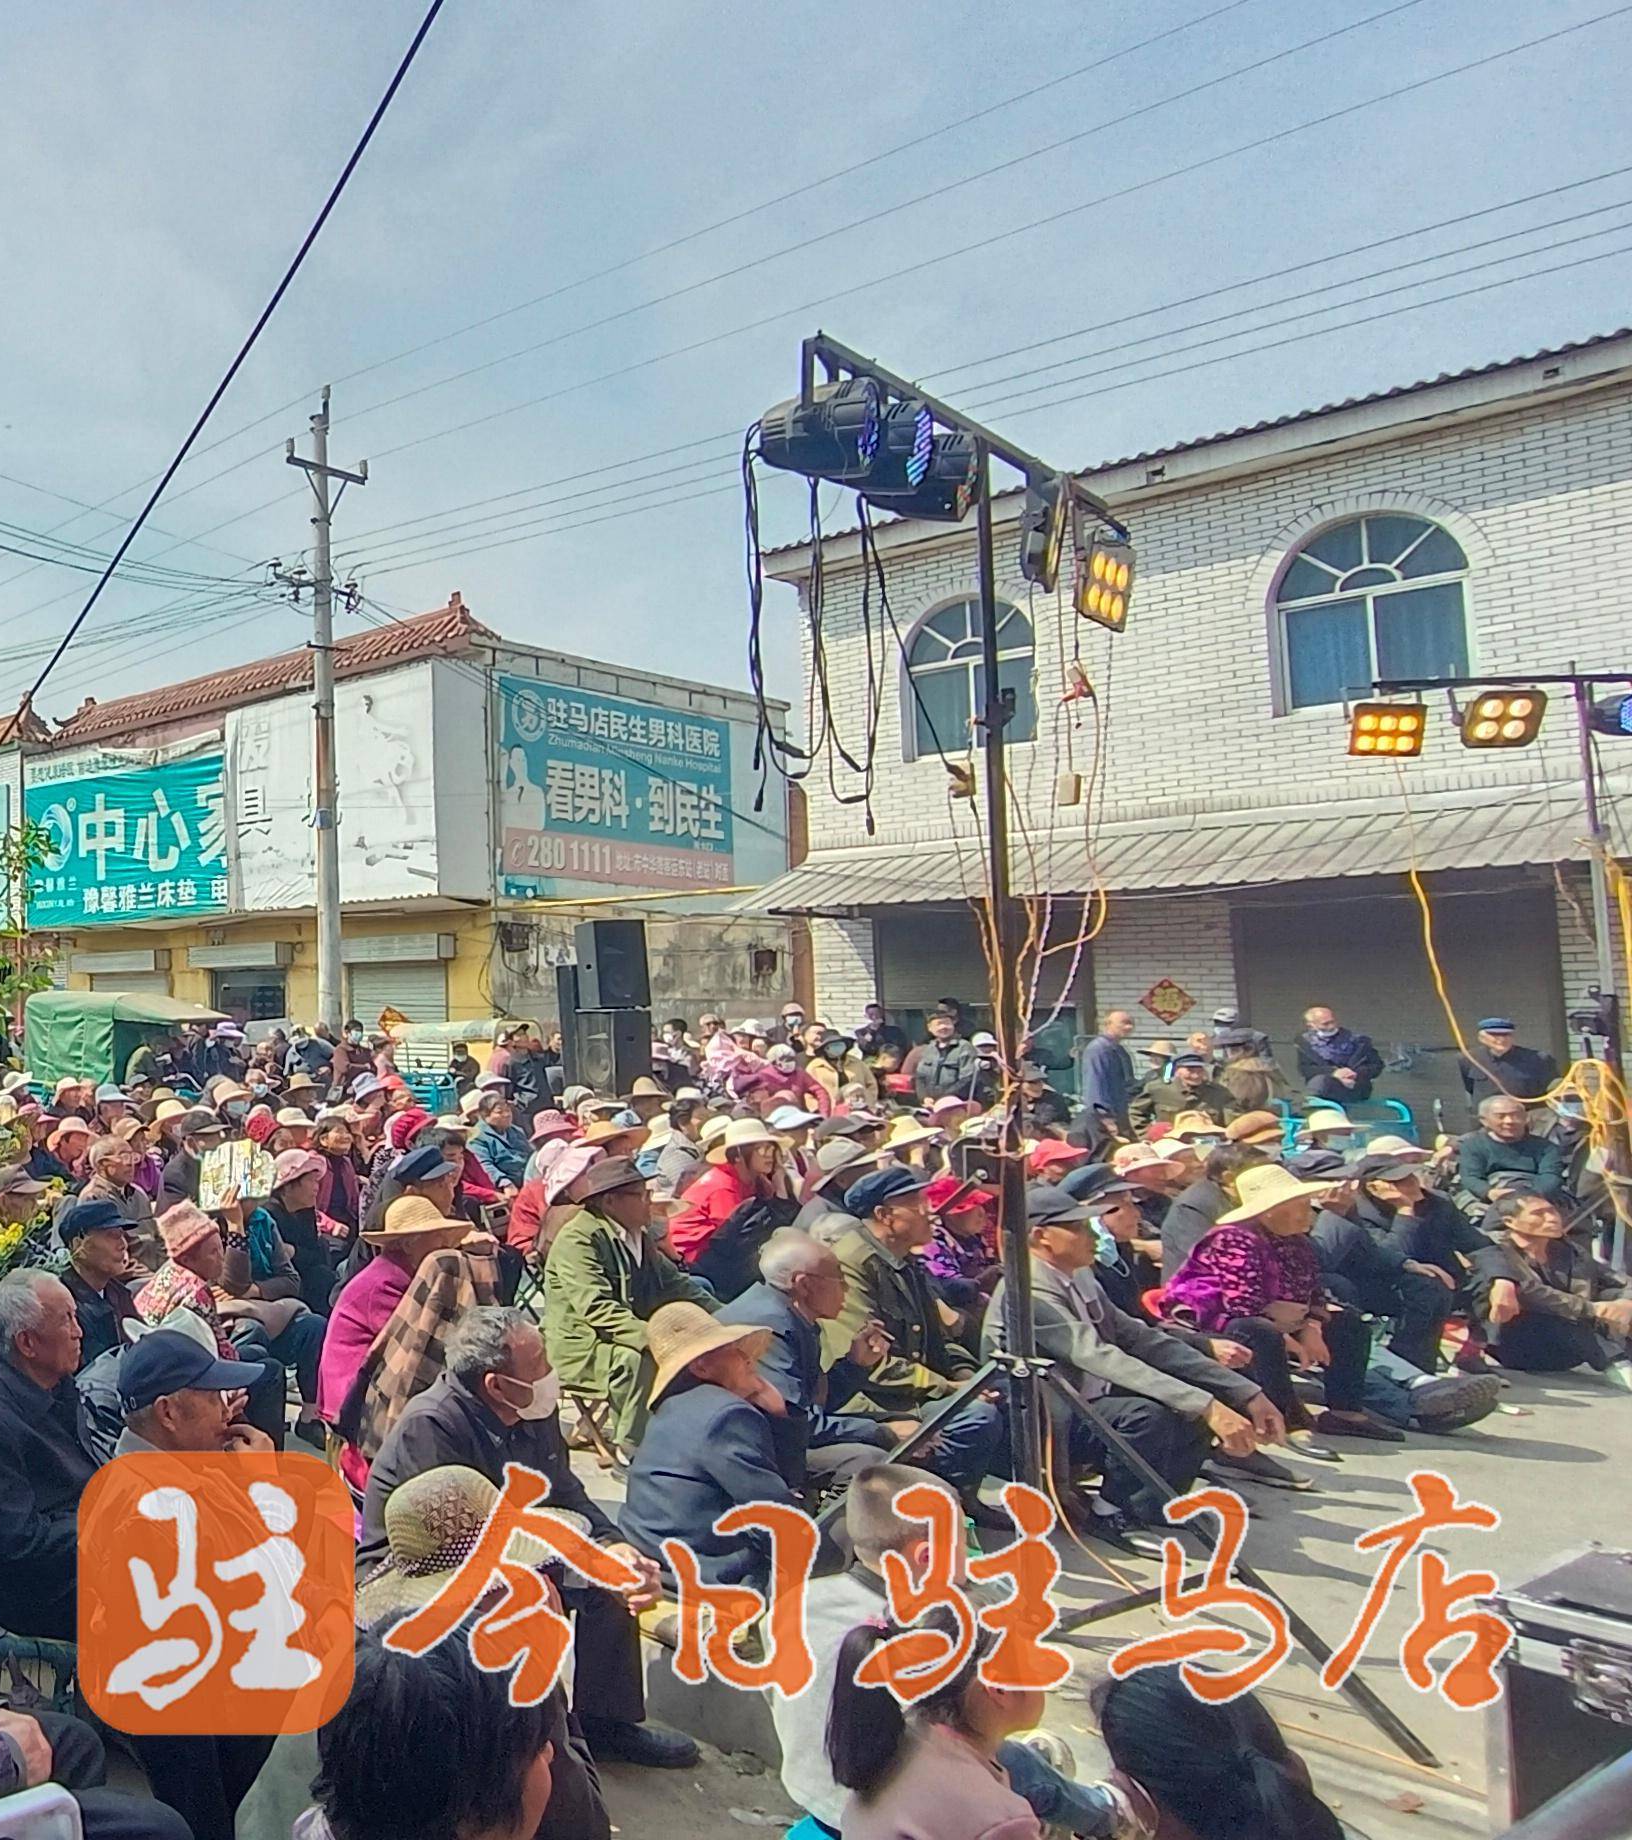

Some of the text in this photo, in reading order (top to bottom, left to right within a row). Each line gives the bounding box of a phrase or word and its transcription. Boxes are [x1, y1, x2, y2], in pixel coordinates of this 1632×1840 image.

[547, 697, 721, 757] 驻马店民生男科医院
[527, 835, 612, 875] 280 1111
